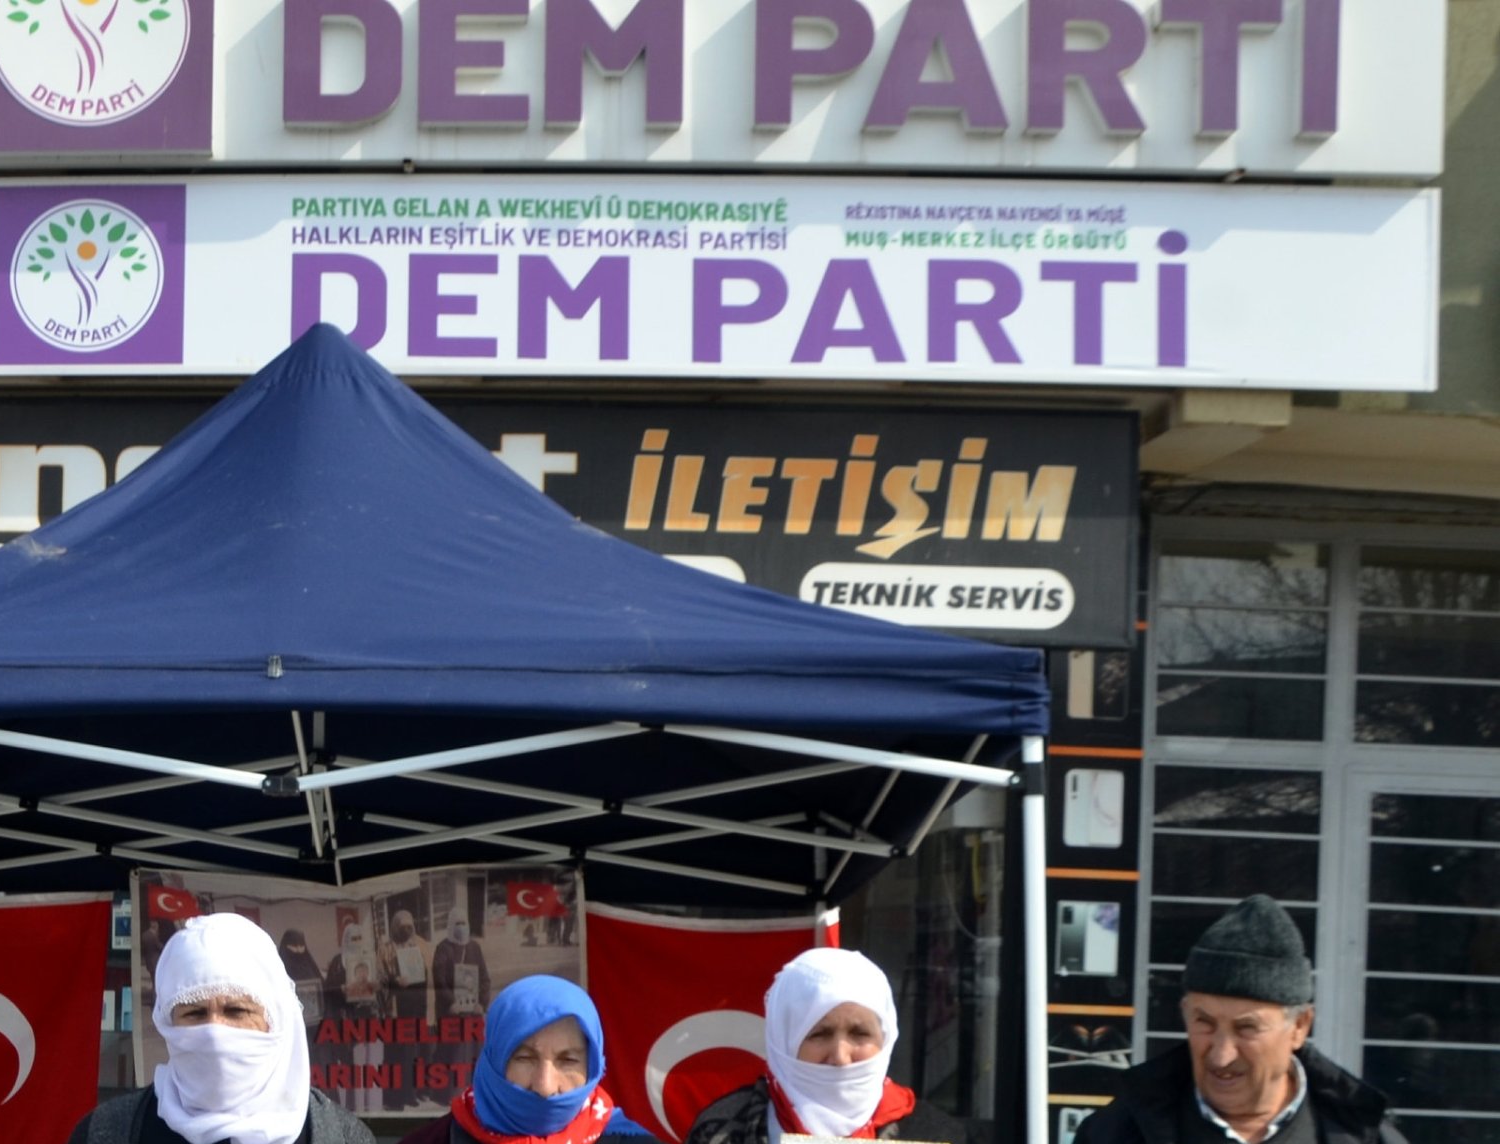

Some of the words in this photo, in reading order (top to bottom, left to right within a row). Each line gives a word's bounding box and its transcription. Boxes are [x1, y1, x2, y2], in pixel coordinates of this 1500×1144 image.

[282, 0, 685, 130] DEM
[31, 84, 76, 115] DEM
[81, 78, 145, 116] PARTİ
[291, 198, 387, 218] PARTIYA
[393, 198, 470, 219] GELAN
[475, 199, 492, 219] A
[499, 195, 602, 221] WEKHEVÎ
[606, 195, 622, 220] Û
[627, 198, 788, 223] DEMOKRASIYÊ
[291, 226, 424, 245] HALKLARIN
[429, 222, 516, 250] EŞİTLİK
[522, 227, 551, 246] VE
[557, 226, 689, 248] DEMOKRASİ
[699, 226, 788, 250] PARTİSİ
[990, 228, 1037, 251] İLÇE
[1043, 229, 1128, 250] ÖRGÜTÜ
[290, 252, 631, 360] DEM
[692, 229, 1189, 367] PARTİ
[44, 318, 77, 342] DEM
[80, 314, 128, 343] PARTİ
[624, 429, 1078, 560] İLETİŞİM
[812, 577, 938, 608] TEKNİK
[946, 581, 1064, 612] SERVİS
[315, 1016, 485, 1044] ANNELER
[310, 1062, 403, 1089] ARINI
[414, 1056, 476, 1089] İST
